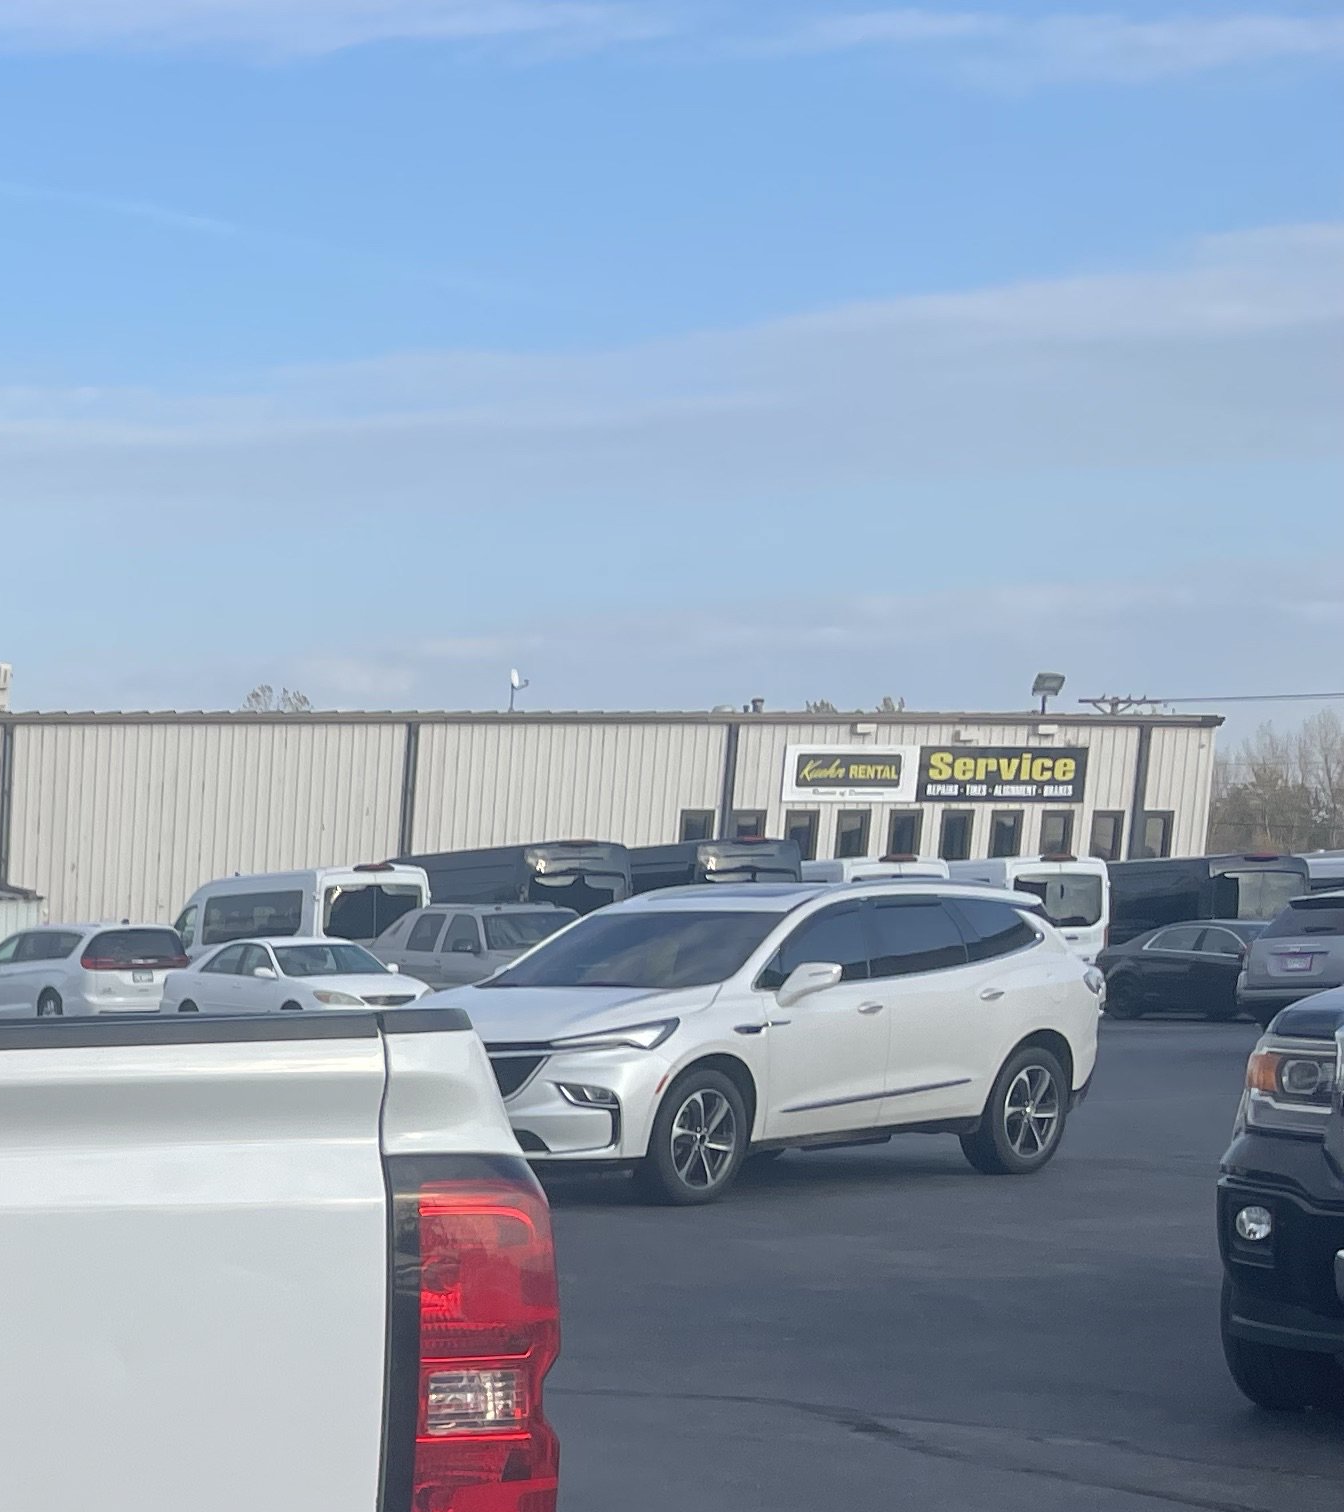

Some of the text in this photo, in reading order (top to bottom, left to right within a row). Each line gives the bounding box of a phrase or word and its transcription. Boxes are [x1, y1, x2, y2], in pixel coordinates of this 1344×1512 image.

[849, 764, 899, 780] RENTAL
[928, 751, 1077, 781] Service
[926, 783, 1073, 797] REPAIRS TIRES ALIGNMENT BRAKES
